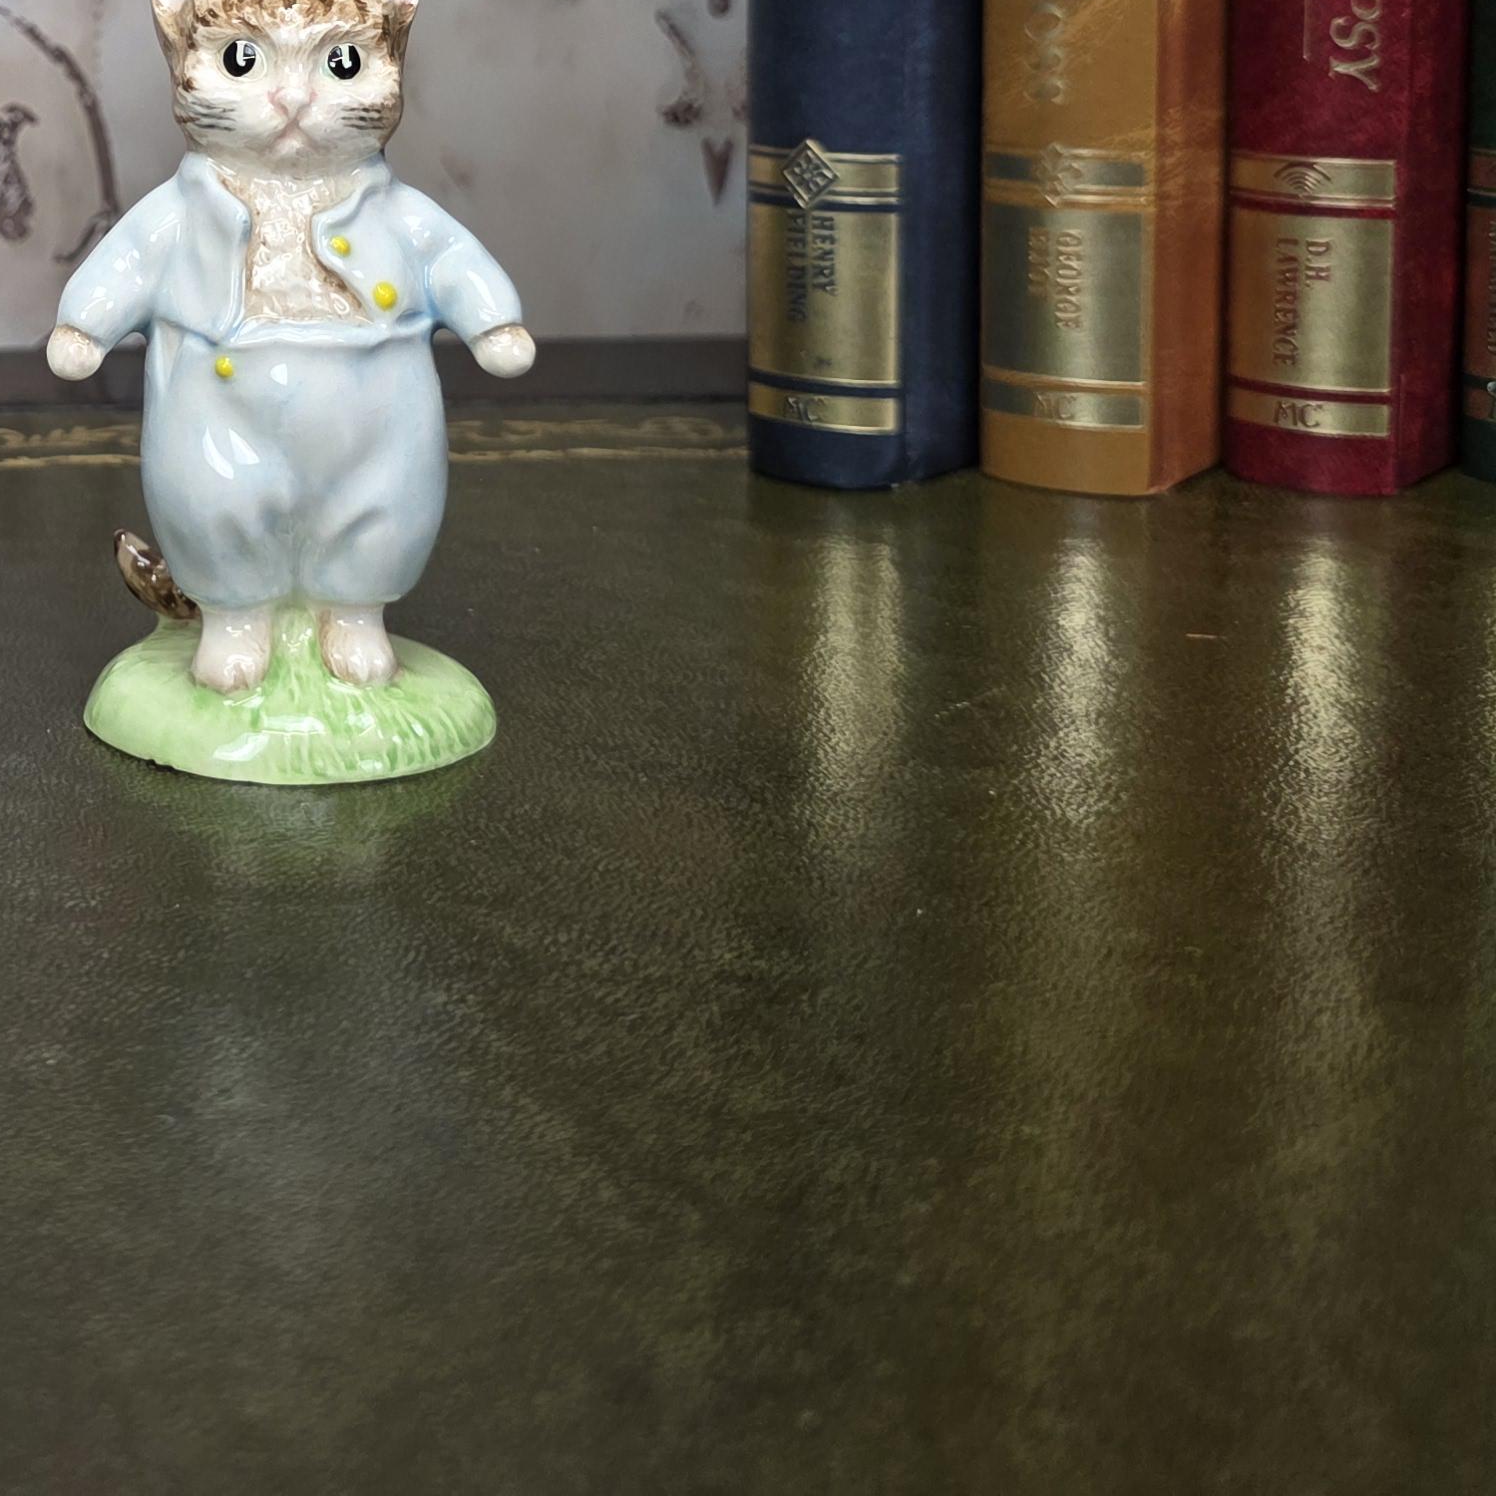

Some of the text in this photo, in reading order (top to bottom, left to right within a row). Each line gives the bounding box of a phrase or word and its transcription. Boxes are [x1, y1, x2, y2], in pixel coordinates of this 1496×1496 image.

[812, 214, 838, 297] HENRY
[1272, 237, 1300, 367] LAWRENCE
[1274, 400, 1323, 428] MC
